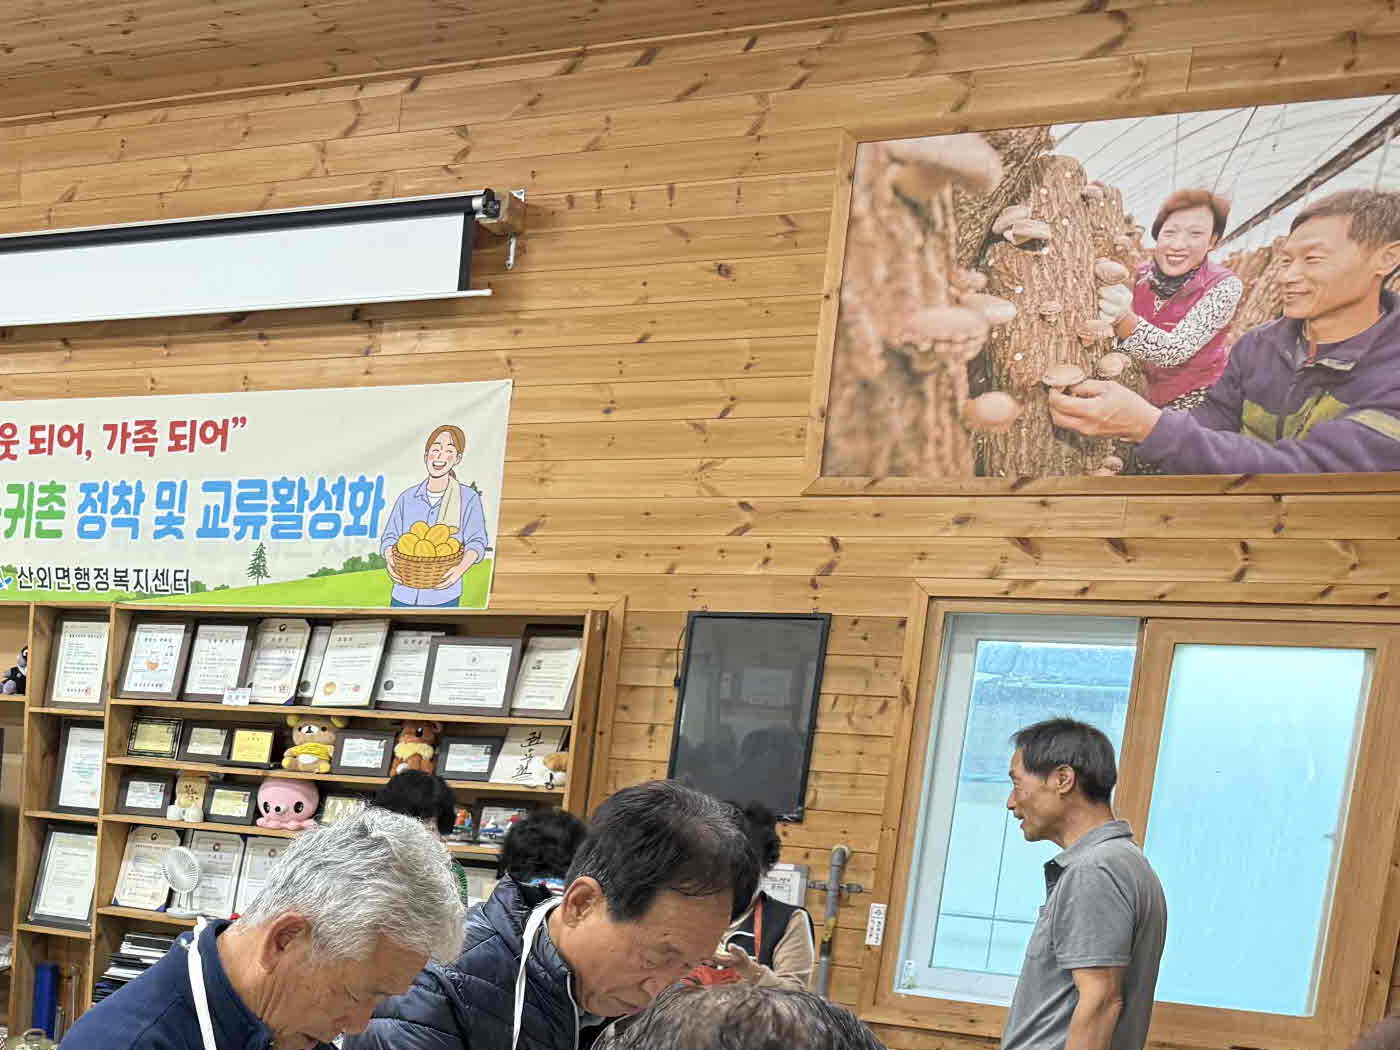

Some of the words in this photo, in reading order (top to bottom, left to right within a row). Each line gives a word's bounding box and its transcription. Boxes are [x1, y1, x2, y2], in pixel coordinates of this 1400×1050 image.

[28, 423, 92, 461] 되어,
[102, 419, 158, 457] 가족
[167, 416, 247, 453] 되어”
[77, 479, 145, 540] 정착
[153, 479, 188, 540] 및
[196, 475, 385, 541] 교류활성화
[17, 566, 190, 594] 산외면행정복지센터
